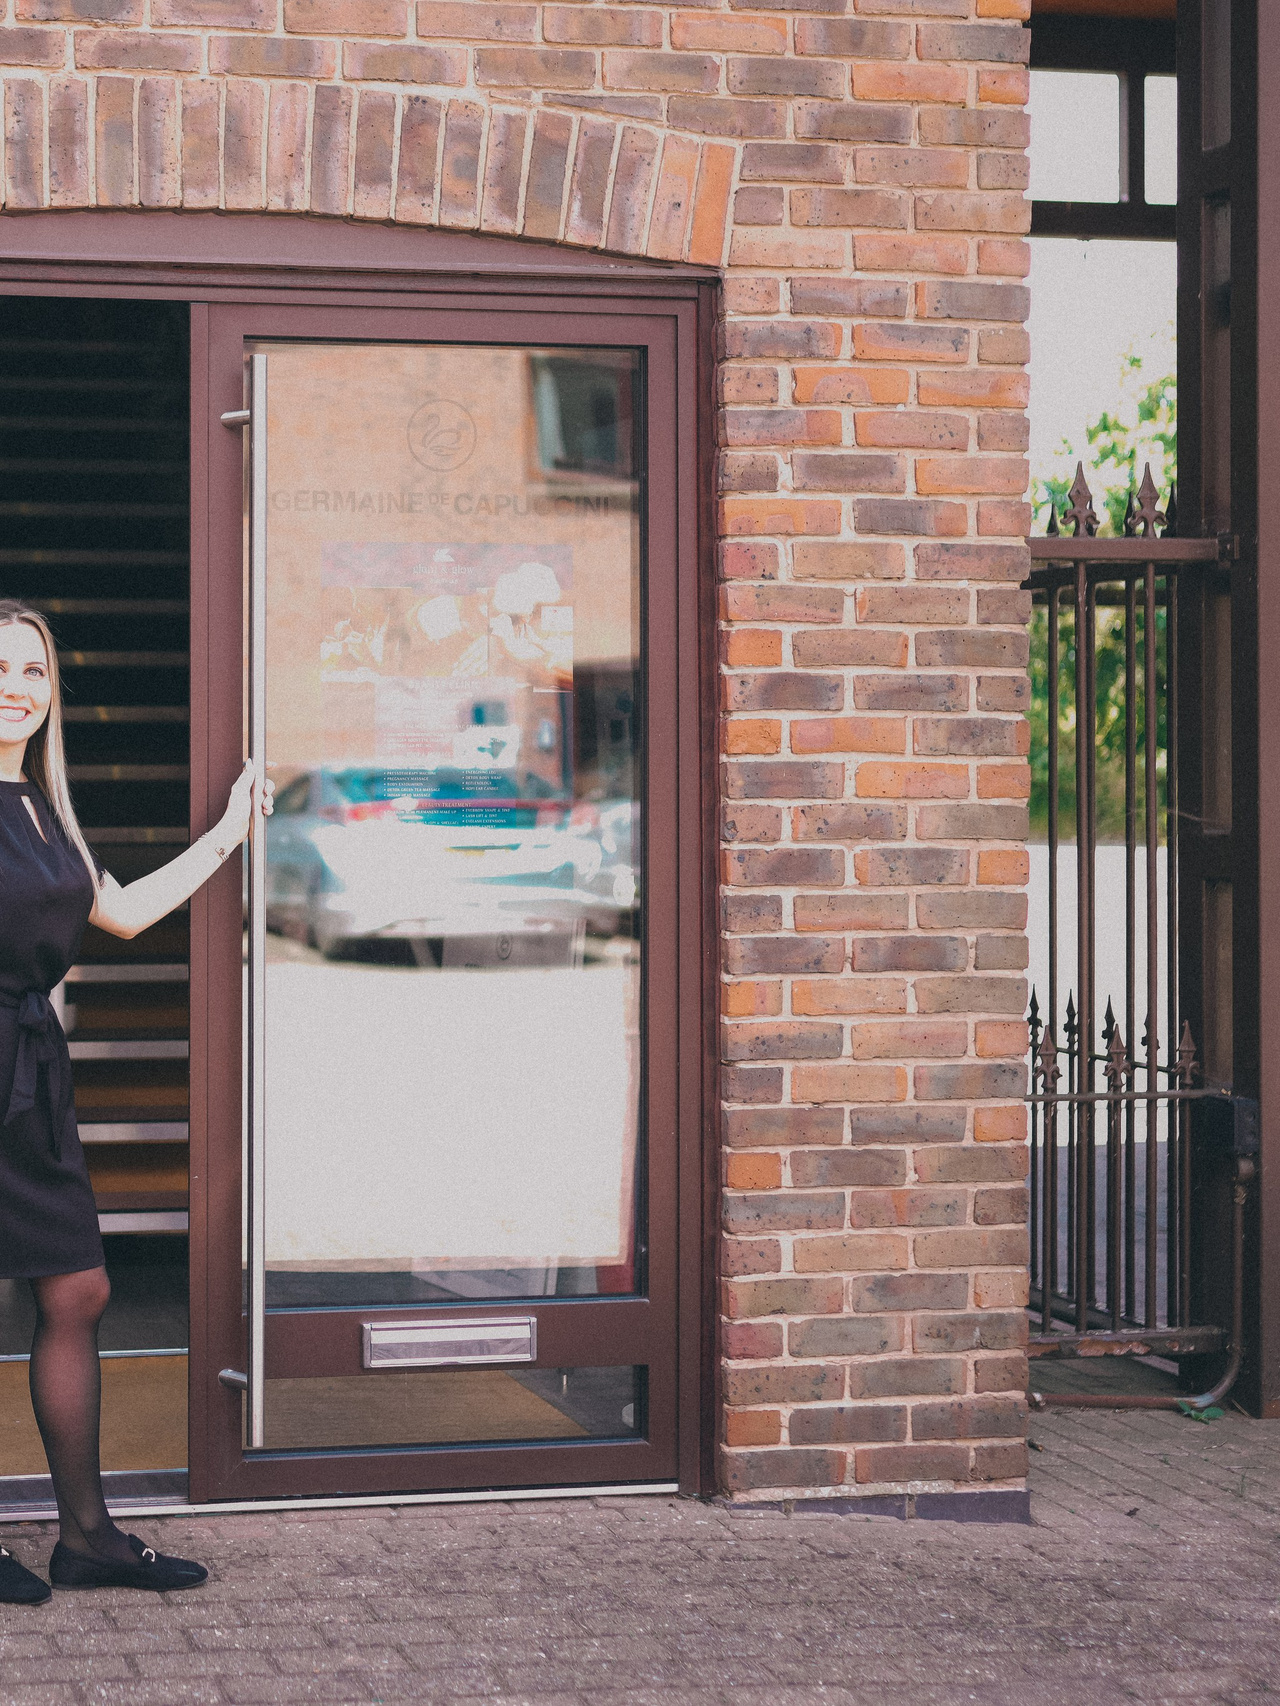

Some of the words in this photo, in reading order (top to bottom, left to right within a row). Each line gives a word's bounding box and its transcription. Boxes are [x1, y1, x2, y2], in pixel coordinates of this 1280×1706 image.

[272, 489, 423, 515] GERMAINE
[428, 493, 450, 506] DE
[453, 492, 610, 518] CAPUCCINI
